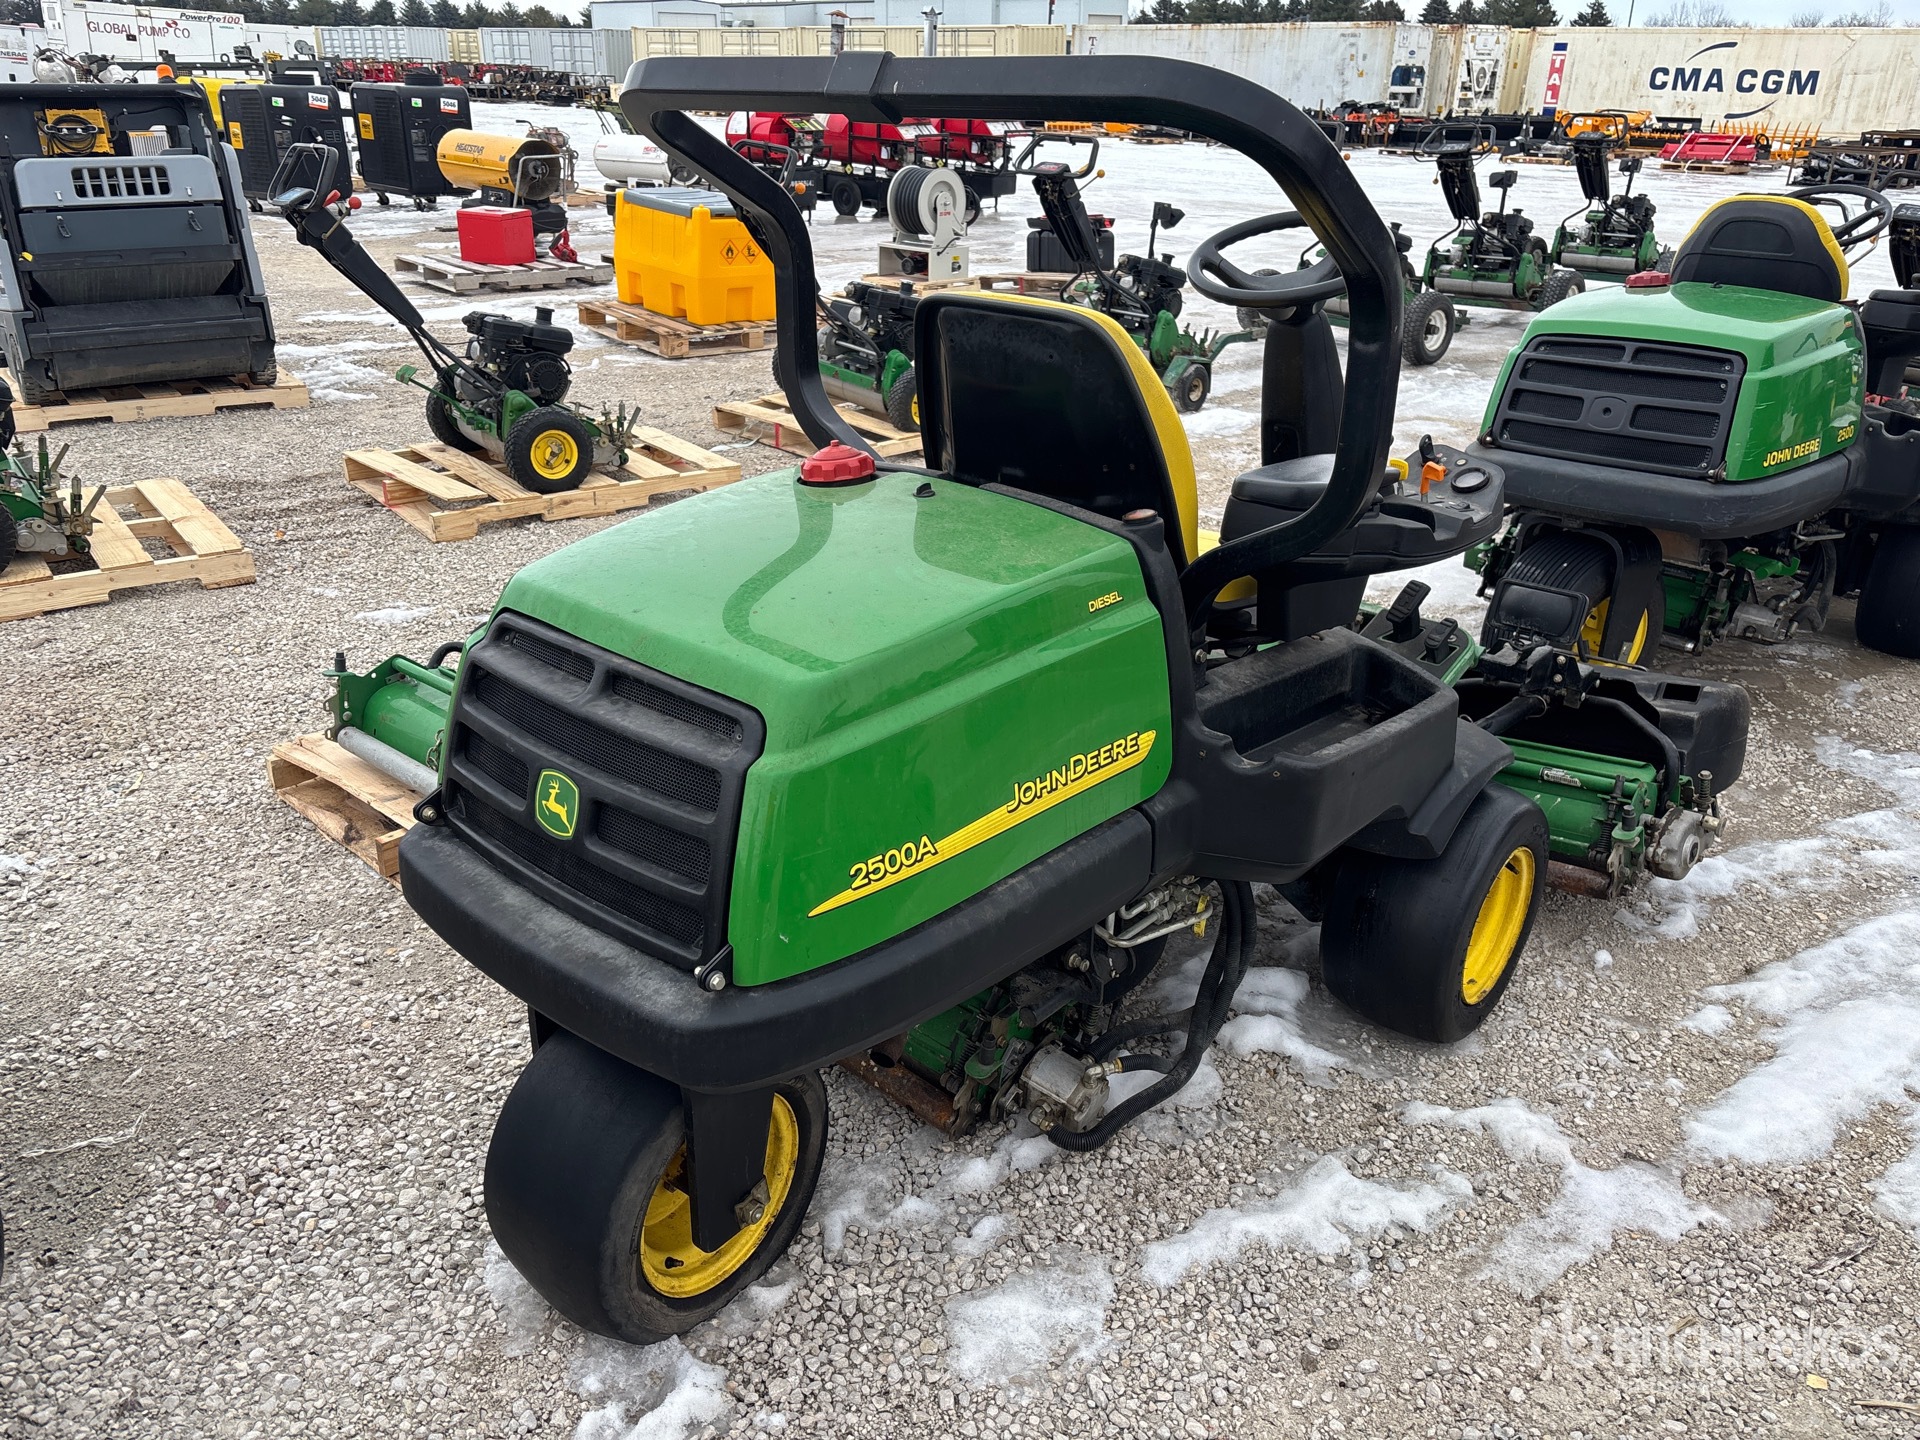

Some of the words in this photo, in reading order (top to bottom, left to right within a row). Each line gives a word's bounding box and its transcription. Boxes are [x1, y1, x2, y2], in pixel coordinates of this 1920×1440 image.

[180, 13, 240, 24] PowerPro100
[87, 21, 132, 35] GLOBAL
[138, 25, 169, 37] PUMP
[173, 28, 190, 38] CO
[1545, 55, 1565, 103] TAL
[1649, 67, 1724, 92] CMA
[1735, 69, 1820, 96] CGM
[311, 95, 326, 103] 5045
[442, 99, 456, 108] 5046
[455, 143, 484, 154] HEATSTAR
[1837, 425, 1855, 443] 2500
[1763, 447, 1792, 468] JOHN
[1793, 438, 1821, 459] DEERE
[1088, 591, 1123, 613] DIESEL
[1006, 765, 1068, 813] JOHN
[1069, 732, 1140, 781] DEERE
[849, 835, 939, 890] 2500A
